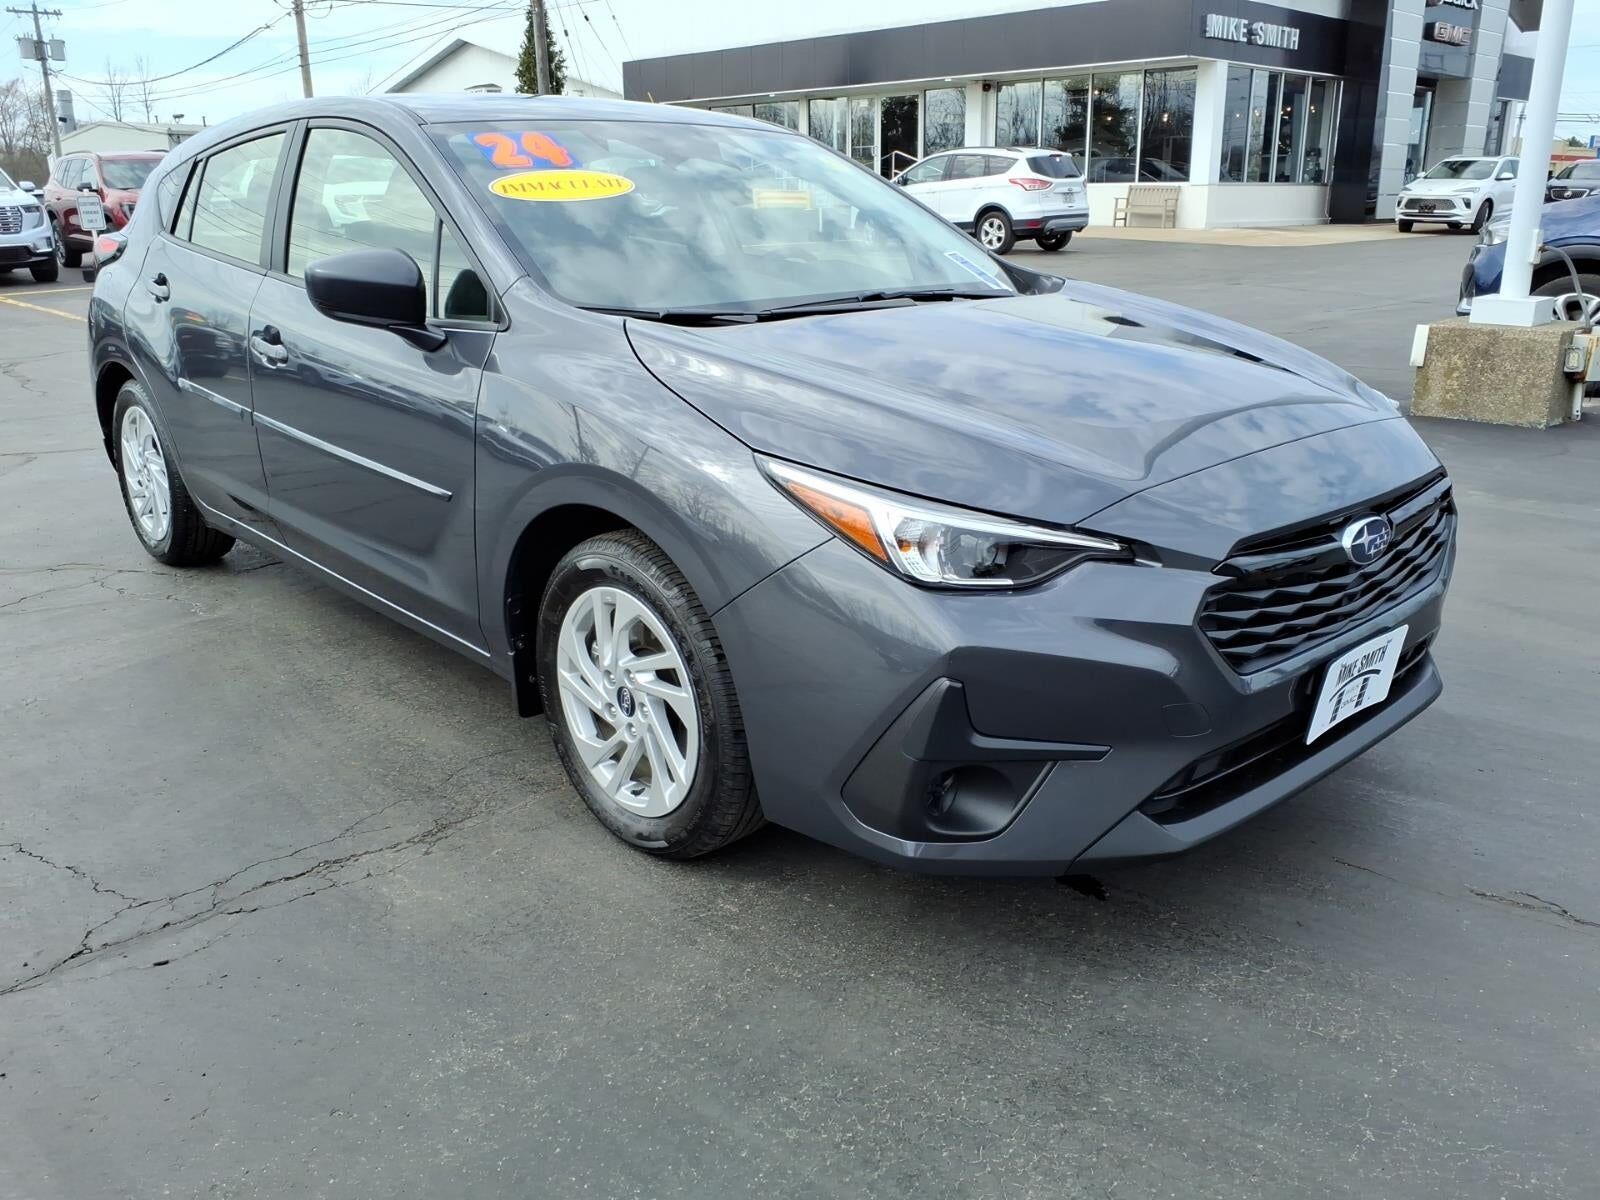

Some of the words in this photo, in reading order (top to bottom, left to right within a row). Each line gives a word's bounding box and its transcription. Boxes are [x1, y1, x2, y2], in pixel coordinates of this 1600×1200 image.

[1206, 14, 1248, 42] MIKE
[1252, 22, 1299, 50] SMITH
[1434, 21, 1472, 46] GMC
[474, 132, 573, 167] 24
[1336, 659, 1360, 687] MIKE
[1358, 643, 1389, 673] SMITH
